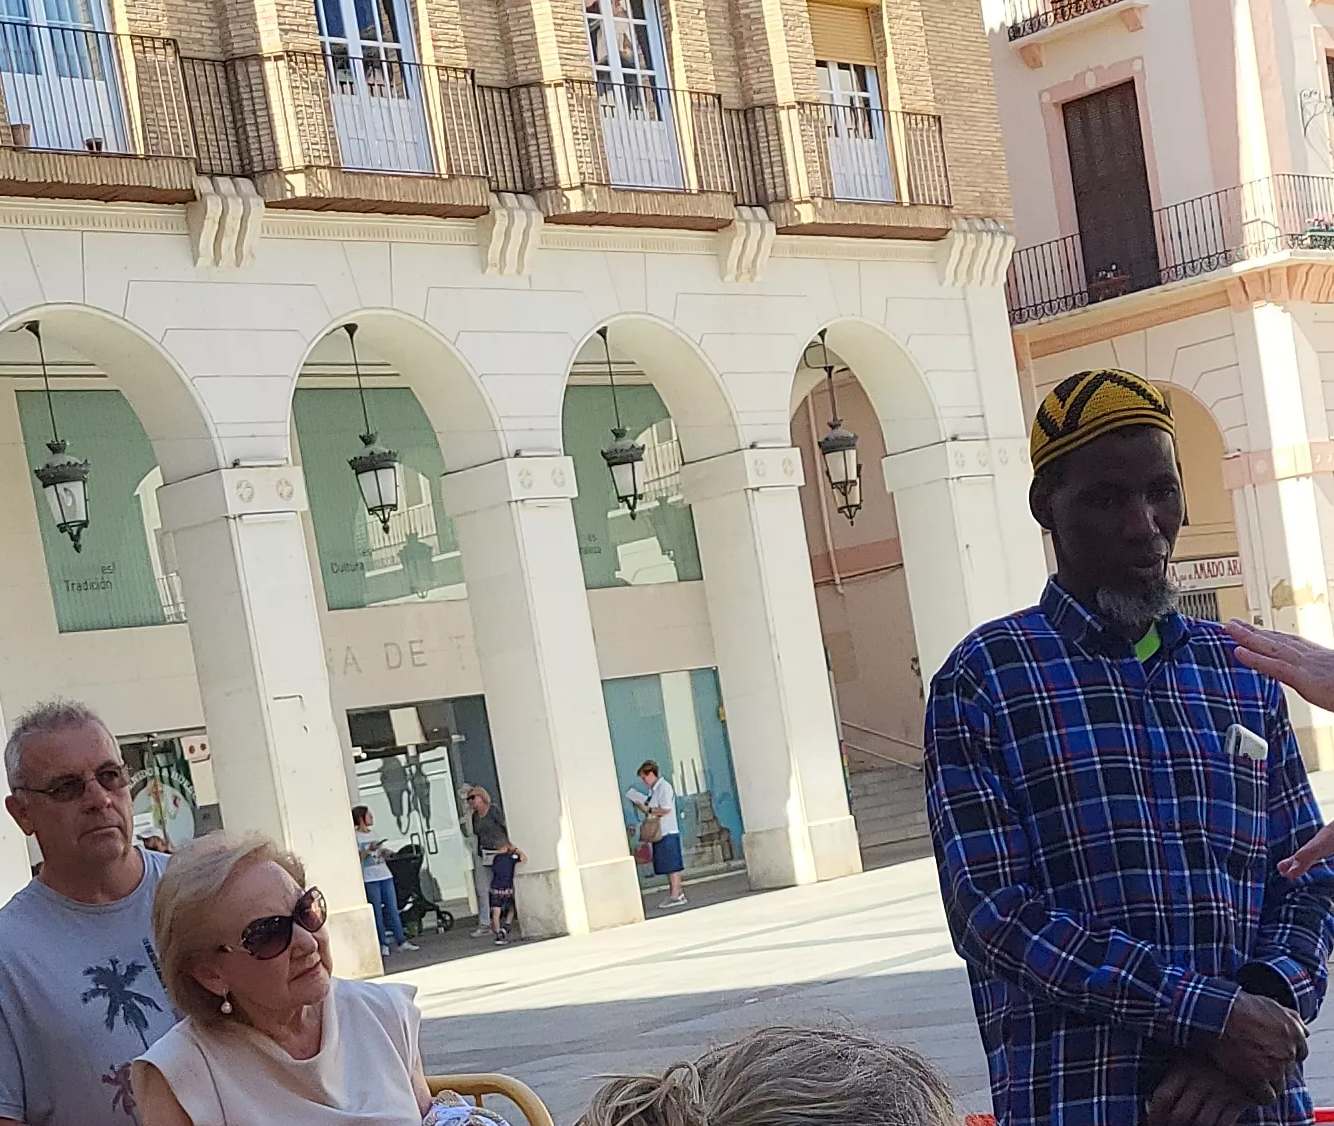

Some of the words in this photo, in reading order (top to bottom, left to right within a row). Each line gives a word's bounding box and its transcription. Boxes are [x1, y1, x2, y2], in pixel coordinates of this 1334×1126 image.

[331, 561, 365, 574] Cultura
[1194, 561, 1225, 579] AMADO
[64, 577, 112, 592] Tradición
[384, 639, 429, 671] DE
